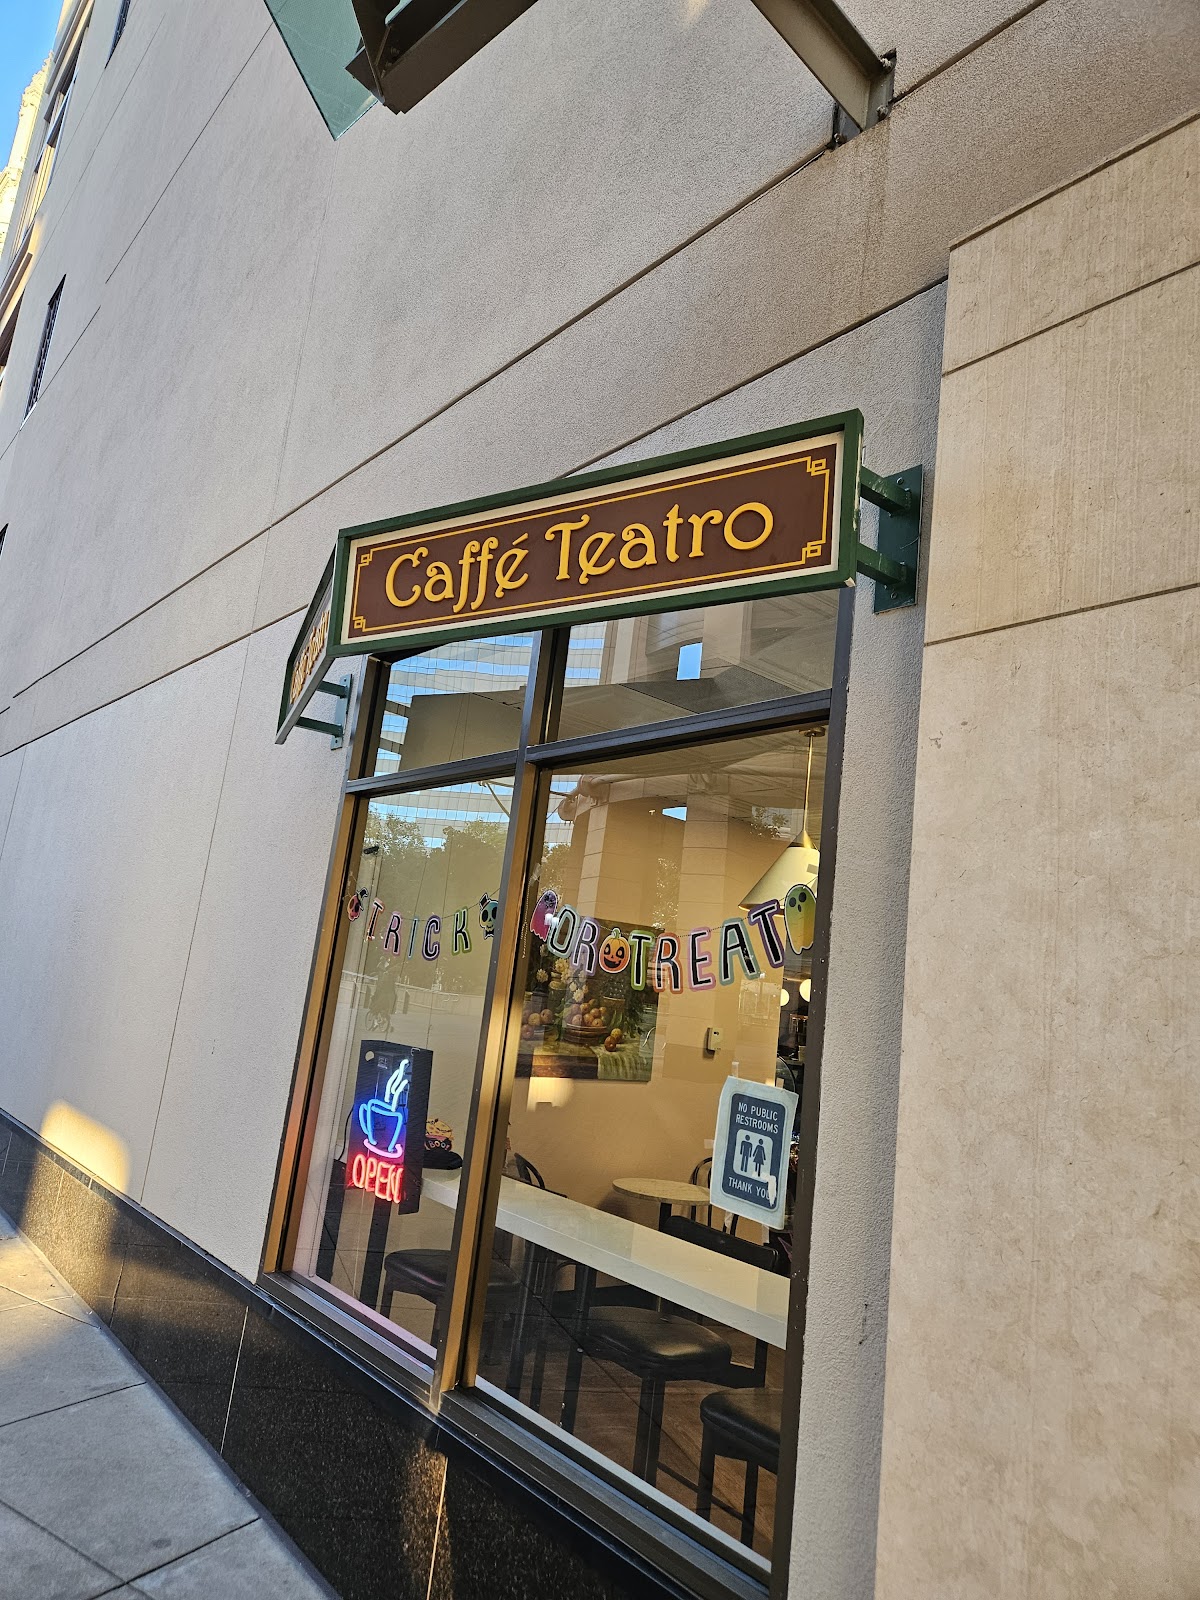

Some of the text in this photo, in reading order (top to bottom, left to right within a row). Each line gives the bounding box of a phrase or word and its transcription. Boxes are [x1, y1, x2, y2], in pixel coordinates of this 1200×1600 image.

[385, 502, 774, 612] Caffé Teatro
[367, 899, 786, 994] TRICK OR TREAT
[736, 1114, 779, 1134] RESTROOMS
[738, 1102, 778, 1121] NO PUBLIC
[352, 1154, 404, 1203] OPEN
[728, 1176, 753, 1194] THANK
